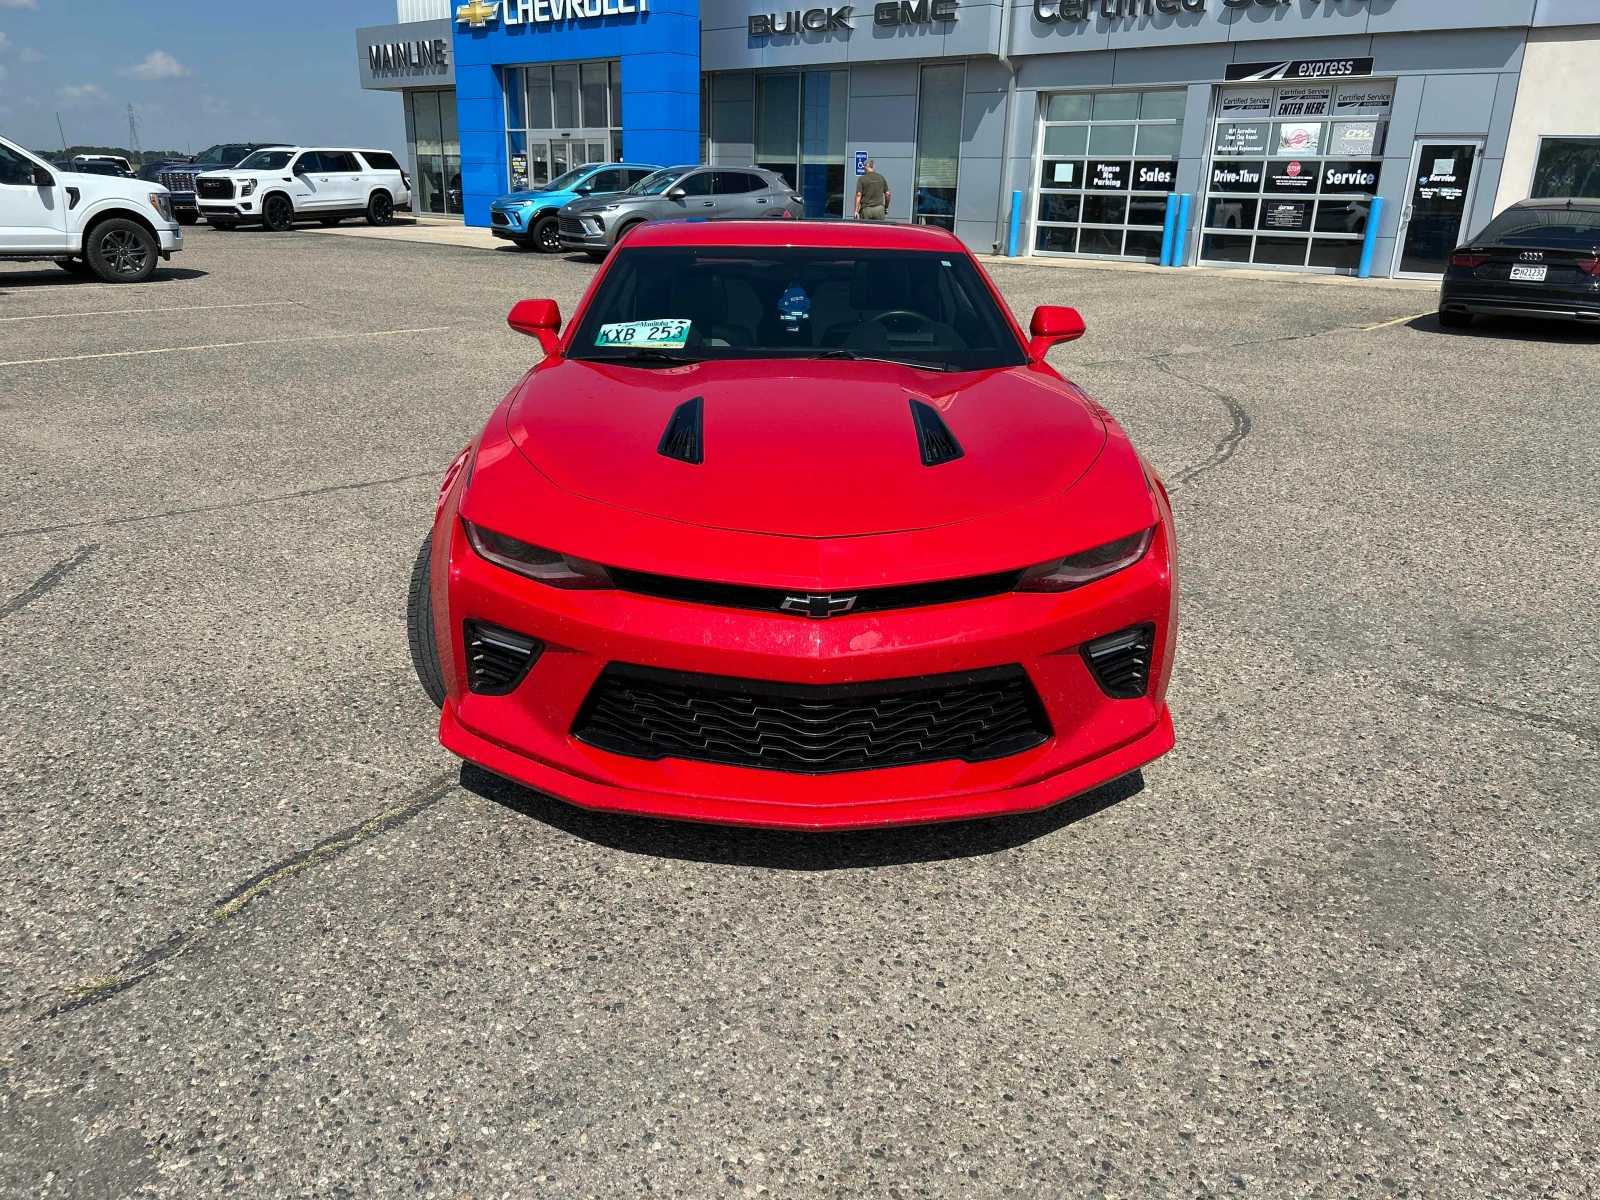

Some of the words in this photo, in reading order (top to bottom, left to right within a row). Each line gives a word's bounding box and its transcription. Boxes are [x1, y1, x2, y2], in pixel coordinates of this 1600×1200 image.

[748, 6, 854, 36] BUICK
[874, 0, 958, 25] GMC
[368, 39, 447, 69] MAINLINE
[1298, 61, 1354, 77] express
[1223, 97, 1248, 105] Certified
[1338, 94, 1365, 102] Certified
[1366, 93, 1391, 101] Service
[1278, 102, 1304, 116] ENTER
[1304, 101, 1327, 115] HERE
[1345, 129, 1371, 137] 0%
[1097, 164, 1120, 173] Please
[1139, 167, 1171, 183] Sales
[1214, 169, 1260, 183] Drive-Thru
[1093, 178, 1121, 188] Parking
[1326, 169, 1375, 185] Service
[600, 328, 636, 342] KXB
[647, 326, 684, 341] 253
